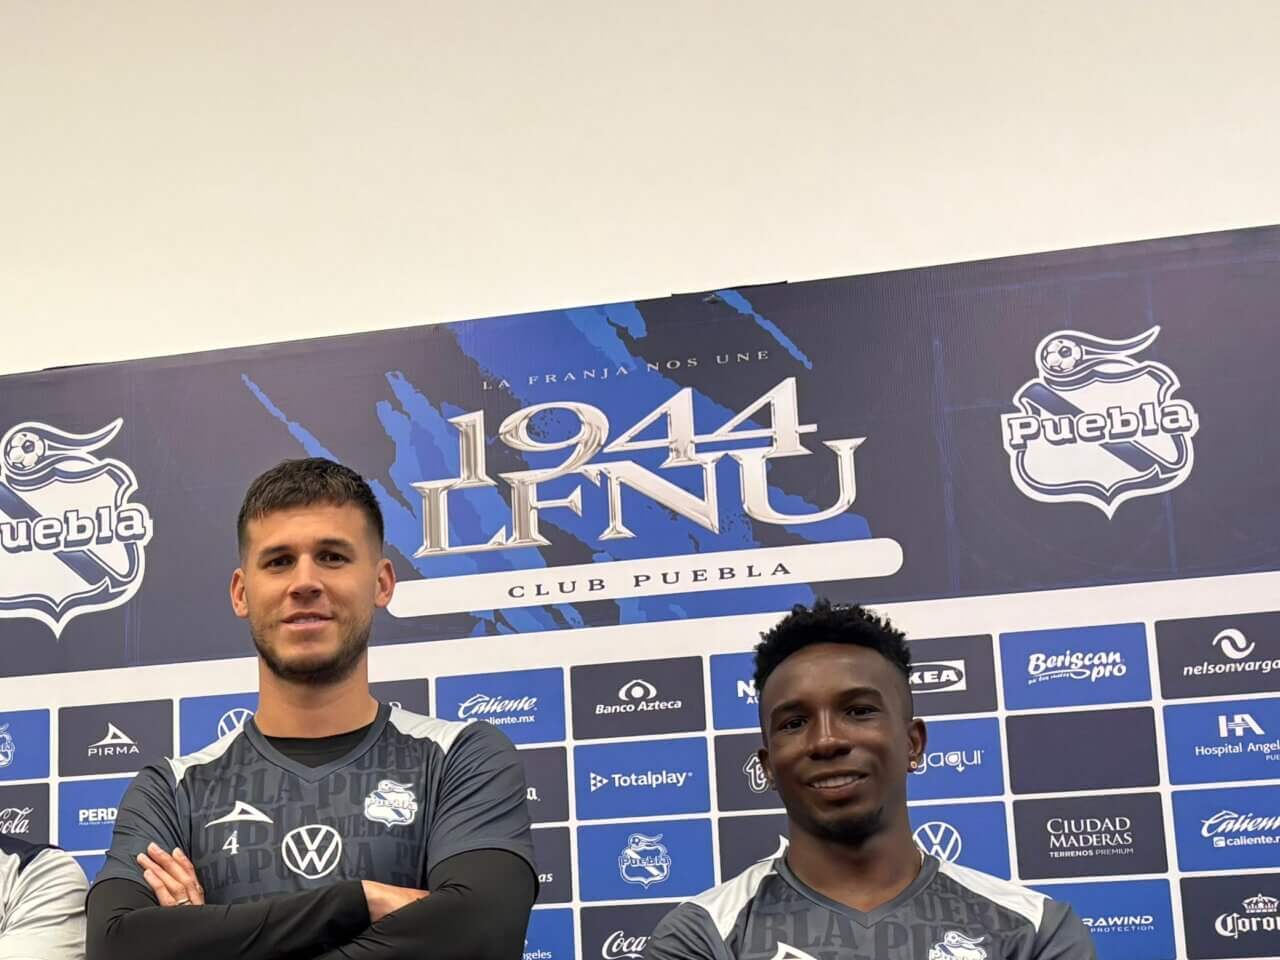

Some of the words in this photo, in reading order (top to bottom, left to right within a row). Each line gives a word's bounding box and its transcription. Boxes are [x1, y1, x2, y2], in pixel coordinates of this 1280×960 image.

[482, 379, 511, 390] LA
[528, 366, 629, 386] FRANJA
[647, 358, 698, 372] NOS
[716, 350, 769, 364] UNE
[448, 377, 818, 486] 1944
[1007, 402, 1193, 450] Puebla
[410, 436, 868, 558] LFNU
[507, 578, 606, 598] CLUB
[633, 562, 791, 587] PUEBLA
[1028, 650, 1121, 676] Beriscan
[1183, 660, 1280, 677] nelsonvarga
[909, 669, 959, 683] KEA
[1091, 663, 1127, 683] pro
[458, 693, 538, 718] Caliente
[595, 701, 636, 714] Banco
[637, 698, 682, 712] Azteca
[88, 745, 140, 757] PIRMA
[1195, 743, 1243, 757] Hospital
[1247, 741, 1280, 754] Angel
[611, 770, 688, 790] Totalplay
[78, 808, 118, 823] PERD
[1046, 817, 1131, 834] CIUDAD
[222, 830, 240, 855] 4
[1049, 832, 1132, 849] MADERAS
[1049, 849, 1093, 858] TERRENOS
[1095, 847, 1134, 856] PREMIUM
[1081, 914, 1154, 927] RAWIND
